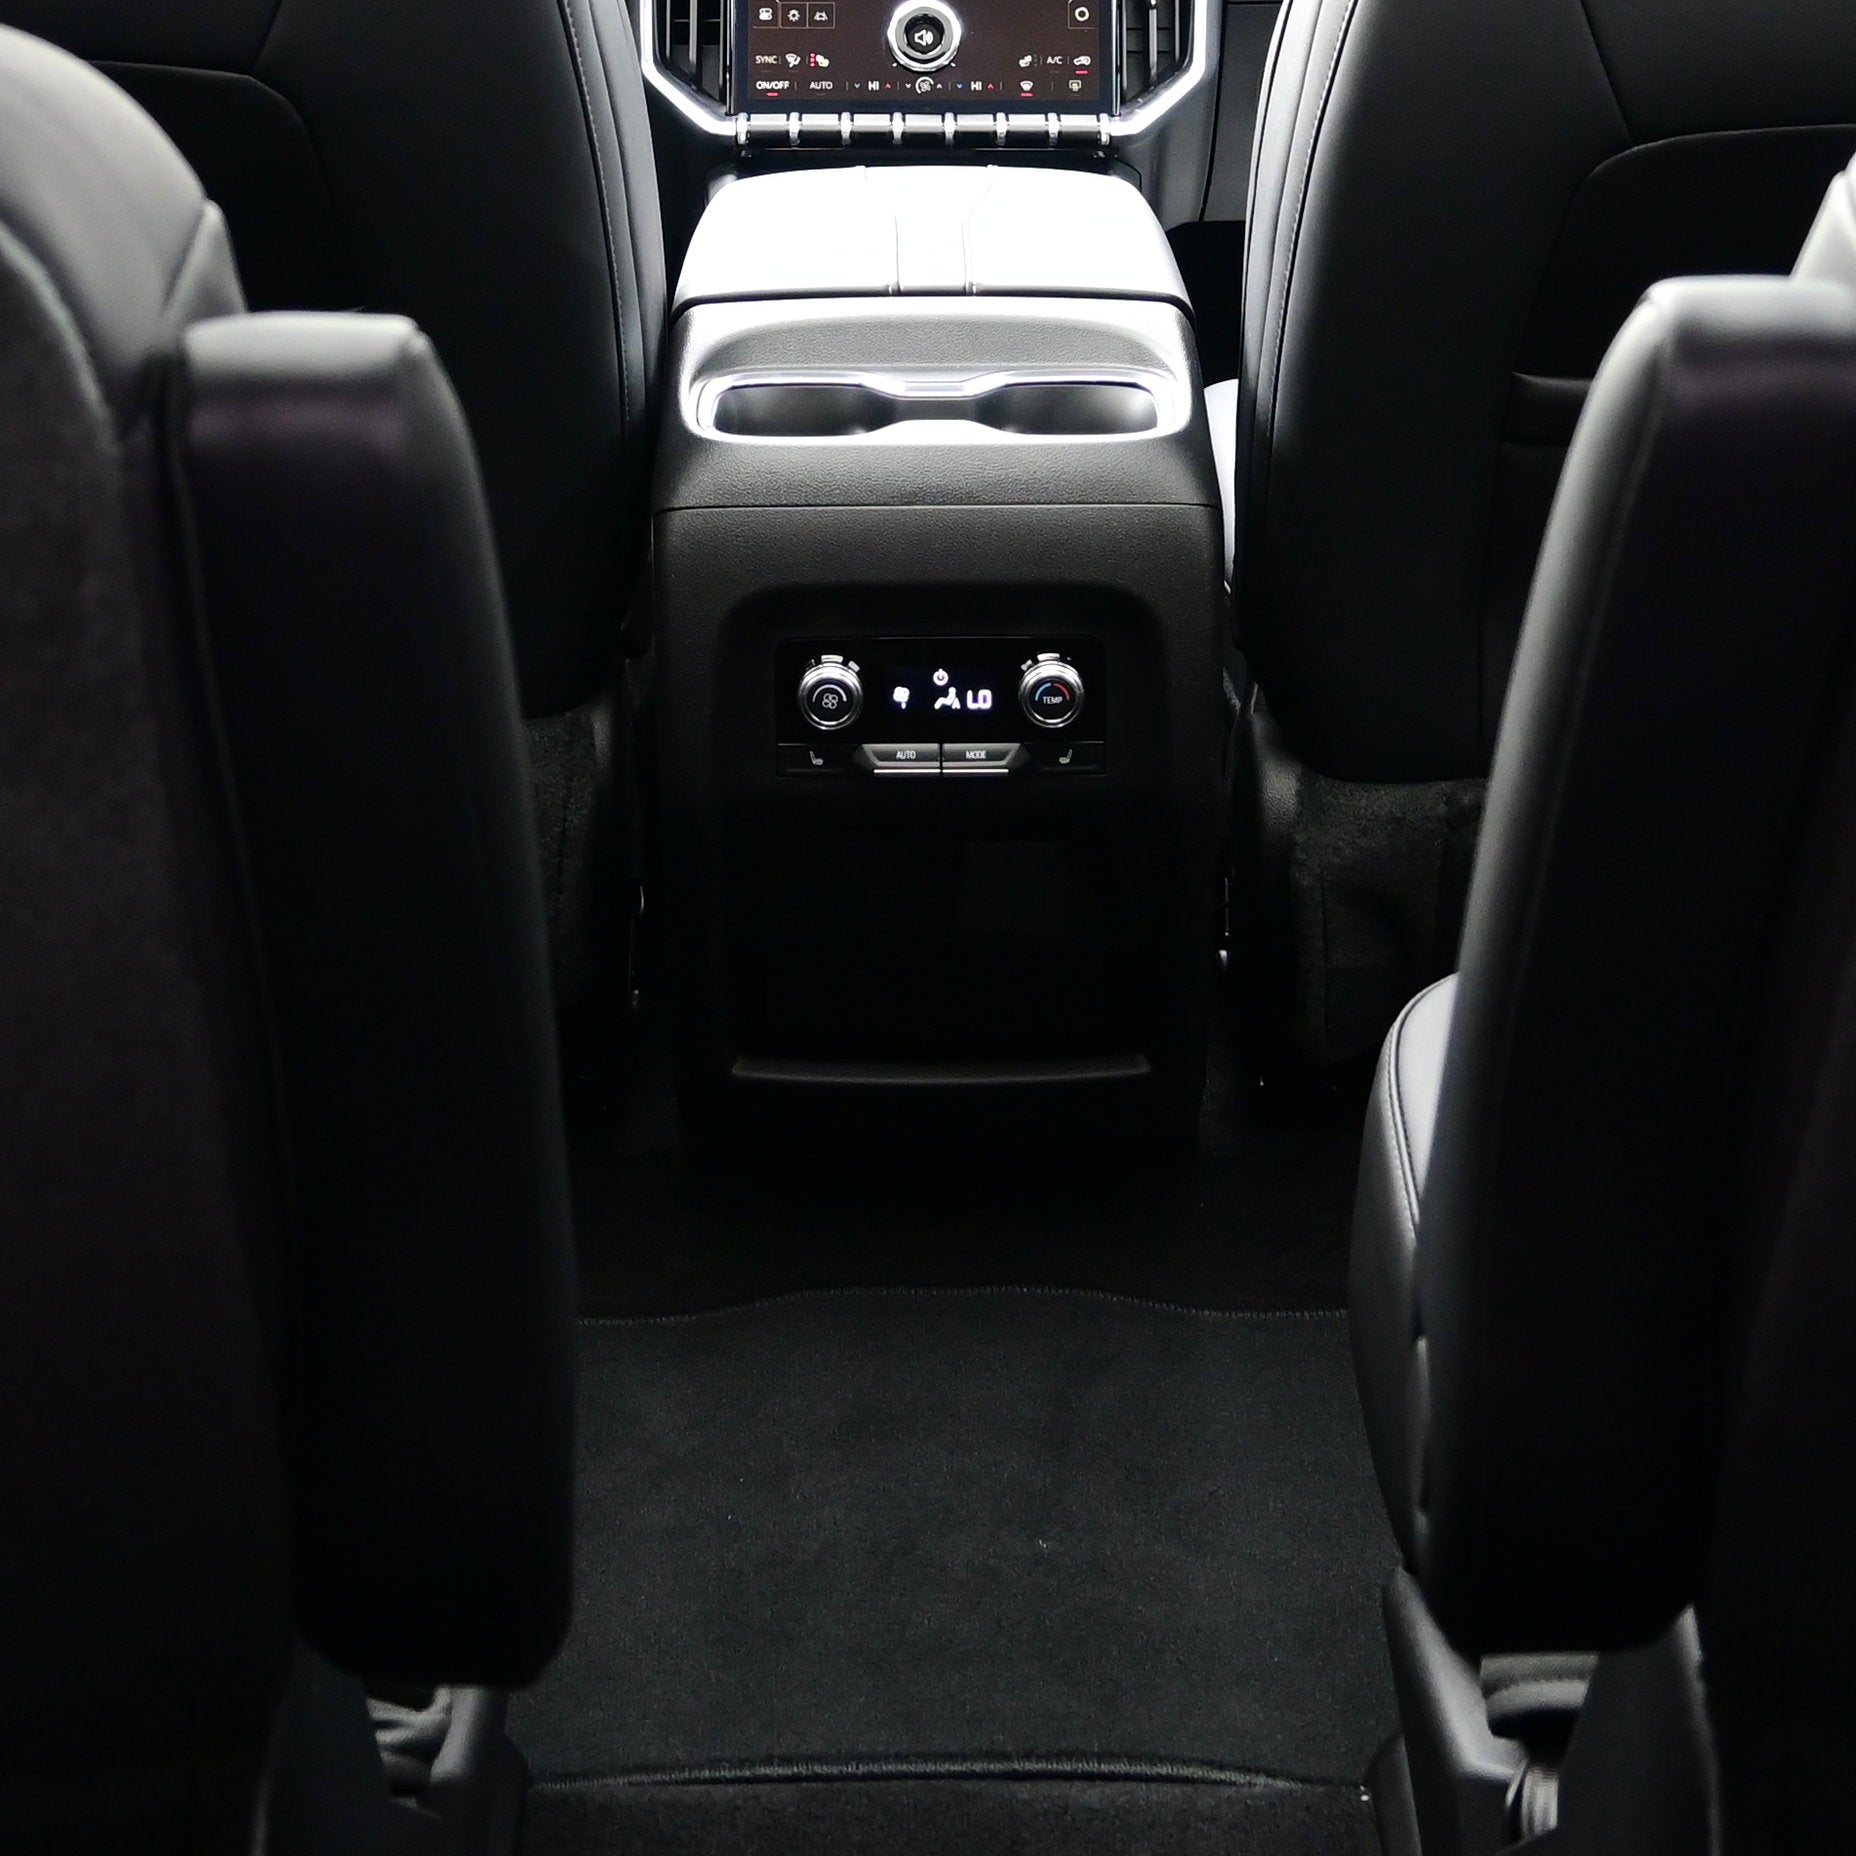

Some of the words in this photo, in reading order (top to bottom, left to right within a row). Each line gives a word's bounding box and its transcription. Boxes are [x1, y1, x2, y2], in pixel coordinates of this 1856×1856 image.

[755, 55, 778, 64] SYNC
[1046, 56, 1063, 65] A/C
[755, 80, 790, 90] ON/OFF
[809, 81, 833, 90] AUTO
[868, 80, 880, 91] HI
[971, 80, 983, 91] HI
[966, 689, 992, 710] LO
[1042, 696, 1063, 705] TEMP
[895, 750, 916, 760] AUTO
[965, 750, 986, 760] MODE
